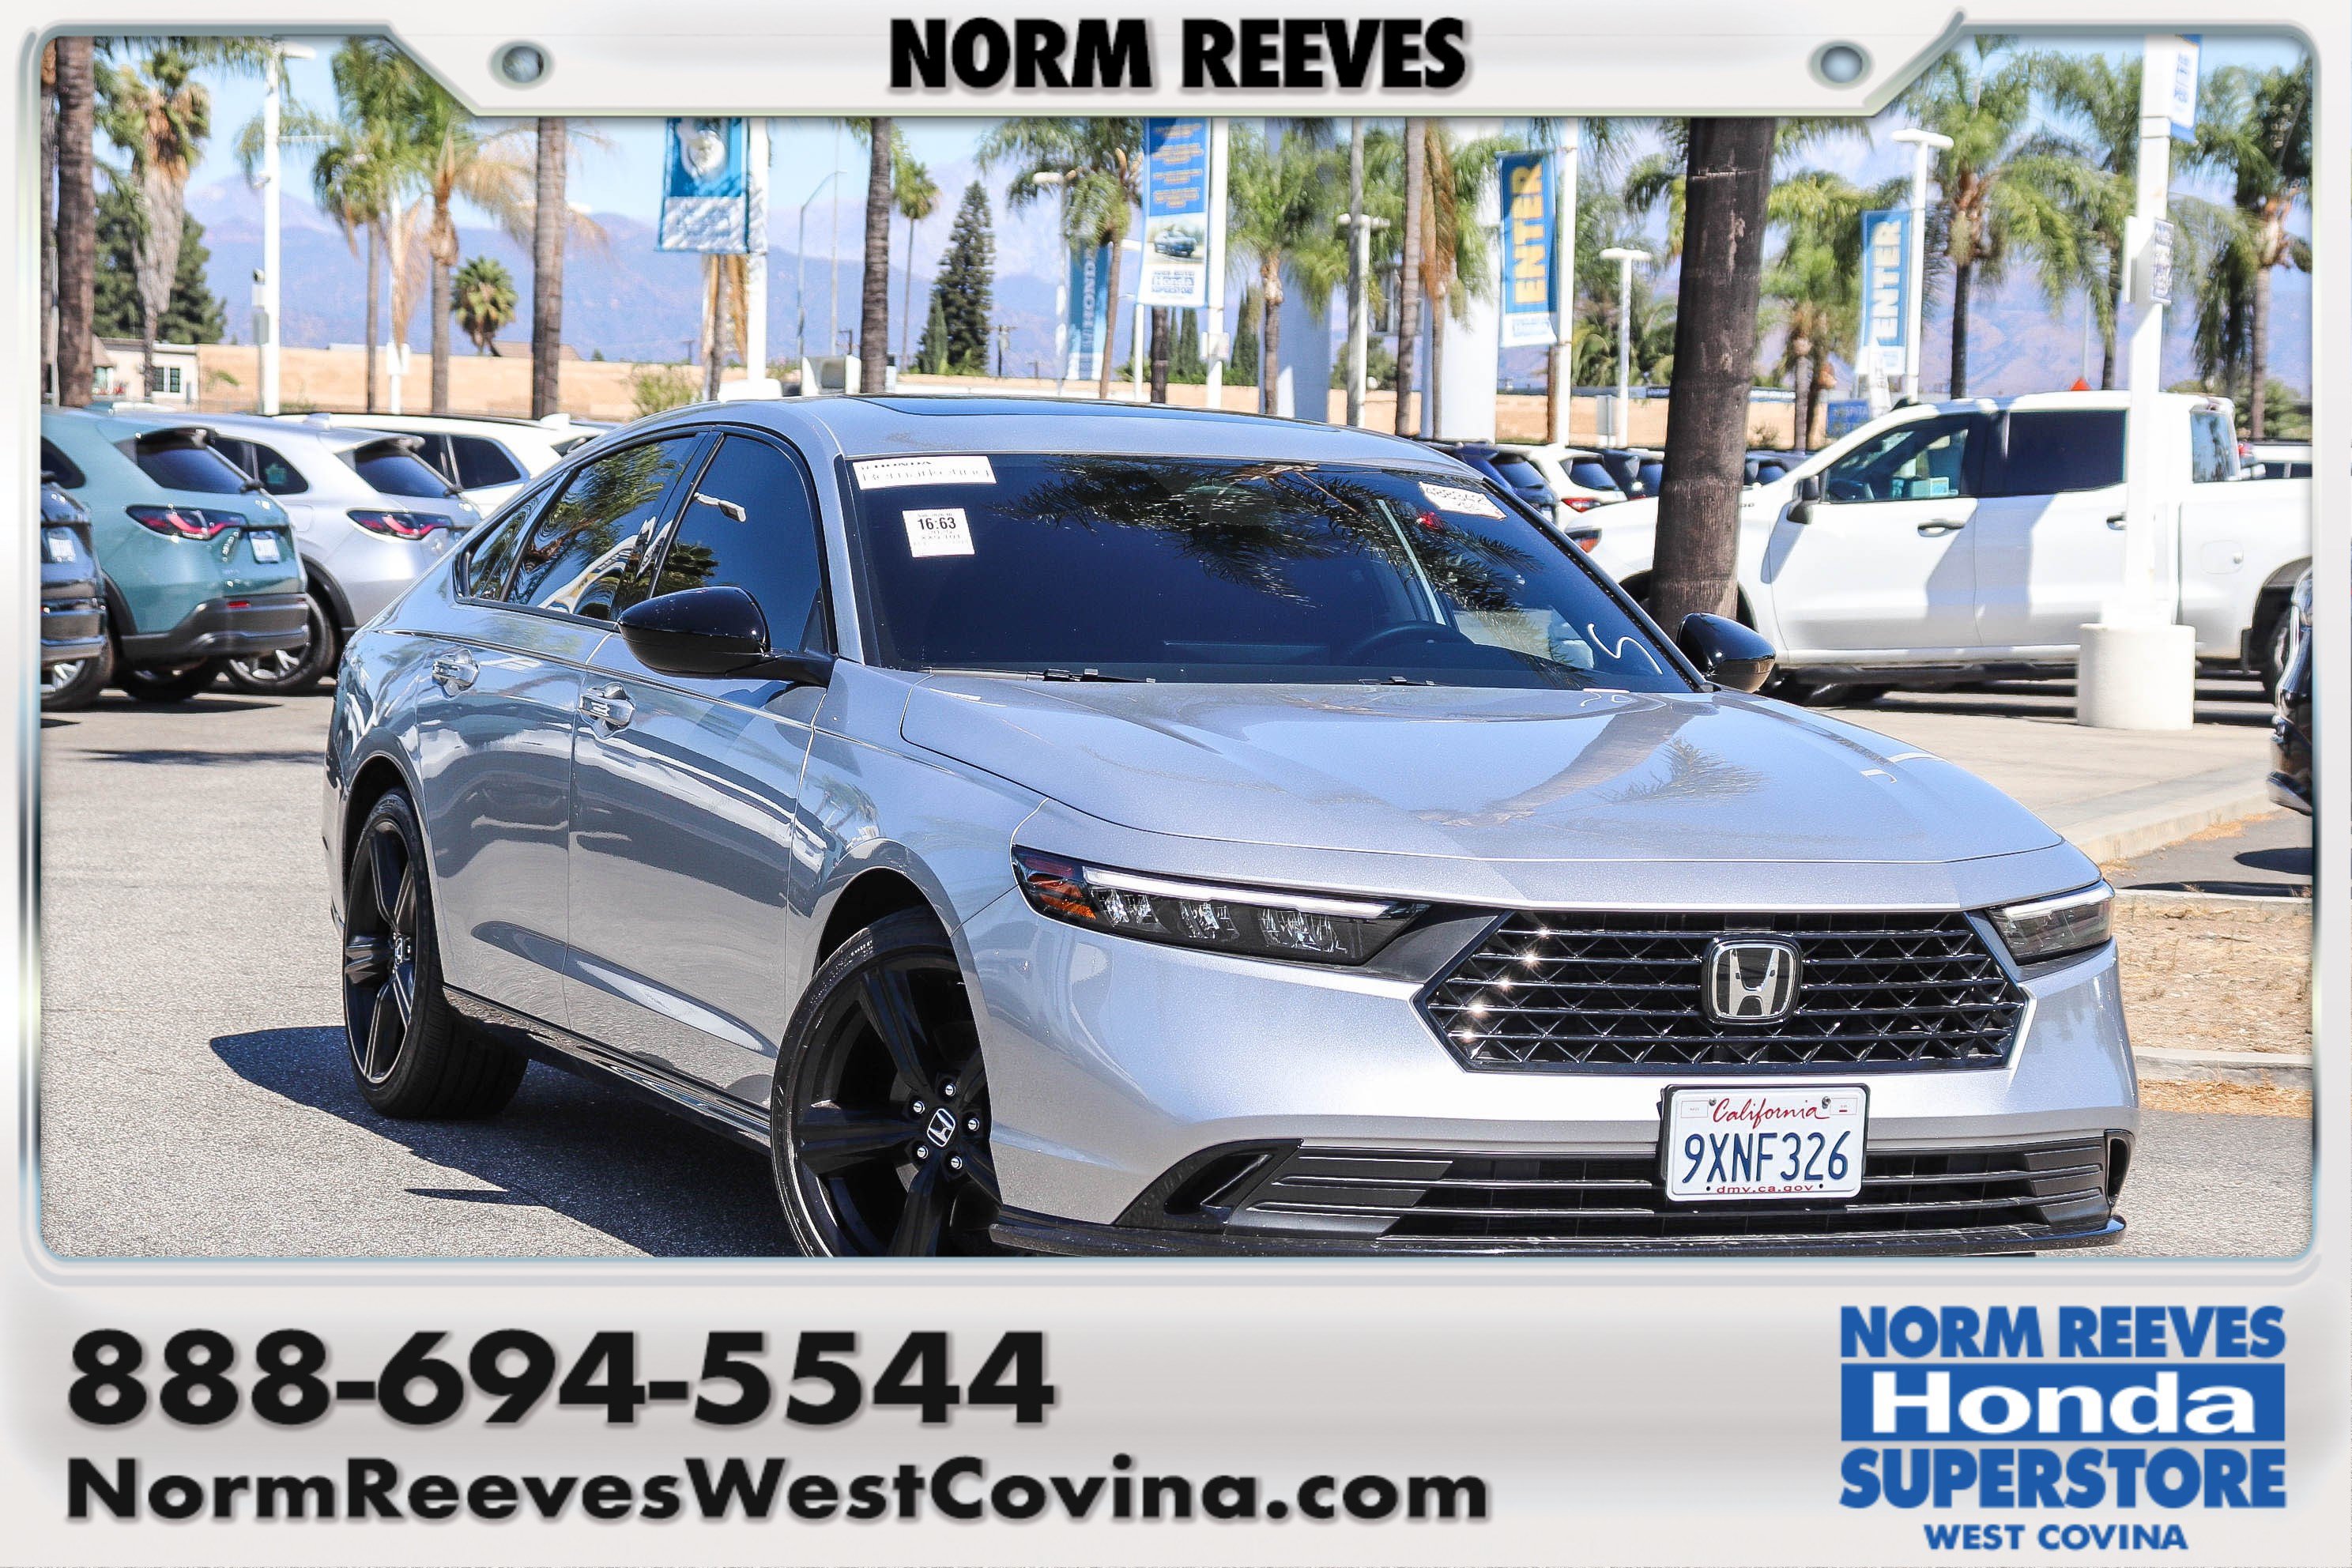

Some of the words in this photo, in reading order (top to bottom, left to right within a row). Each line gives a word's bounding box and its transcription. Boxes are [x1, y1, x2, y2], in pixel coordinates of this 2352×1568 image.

[1511, 162, 1547, 304] ENTER
[1871, 220, 1902, 340] ENTER
[917, 517, 957, 530] 16:63
[1713, 1097, 1830, 1130] California
[1681, 1130, 1852, 1184] 9XNF326
[1716, 1184, 1815, 1194] dmv.ca.gov
